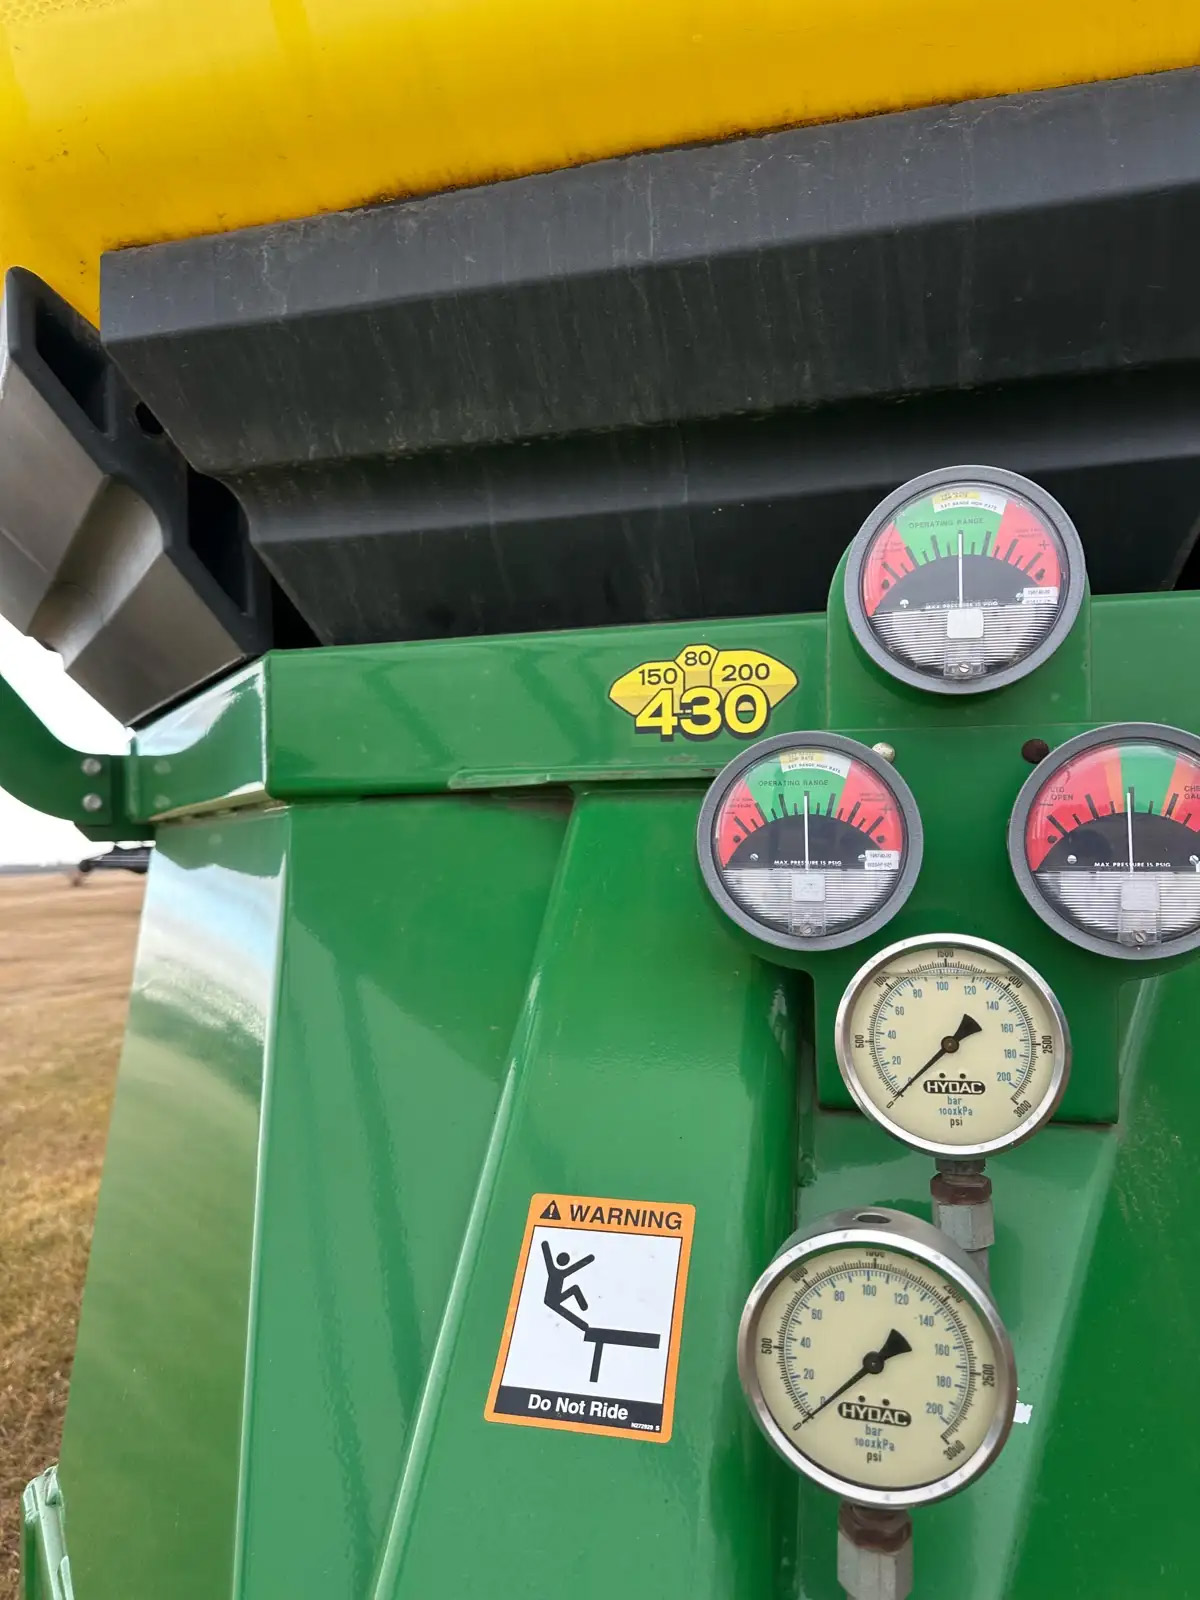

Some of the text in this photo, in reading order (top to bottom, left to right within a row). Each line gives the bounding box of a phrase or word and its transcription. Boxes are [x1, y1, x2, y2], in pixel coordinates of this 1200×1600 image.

[908, 517, 984, 529] OPERATING RANGE
[684, 650, 712, 666] 80
[638, 667, 678, 686] 150
[721, 662, 771, 682] 200
[635, 683, 770, 739] 430
[1051, 793, 1074, 801] OPEN
[936, 981, 949, 991] 100
[964, 985, 977, 996] 120
[912, 988, 923, 999] 80
[895, 1006, 905, 1016] 60
[986, 1000, 1000, 1011] 140
[1001, 1023, 1014, 1033] 160
[854, 1034, 865, 1049] 500
[887, 1030, 897, 1040] 40
[1041, 1035, 1053, 1054] 2500
[892, 1055, 902, 1065] 20
[1004, 1048, 1017, 1059] 180
[997, 1071, 1012, 1082] 200
[926, 1081, 983, 1094] HYDAC
[886, 1100, 894, 1109] 0
[947, 1095, 962, 1105] bar
[939, 1105, 973, 1116] 100xkPa
[1013, 1100, 1032, 1118] 3000
[950, 1116, 963, 1129] psi
[570, 1204, 682, 1230] WARNING
[789, 1267, 808, 1283] 1000
[834, 1290, 845, 1301] 80
[863, 1284, 877, 1296] 100
[894, 1293, 909, 1305] 120
[811, 1308, 822, 1320] 60
[919, 1314, 934, 1327] 140
[761, 1337, 773, 1354] 500
[800, 1337, 811, 1348] 40
[935, 1343, 950, 1356] 160
[804, 1368, 815, 1380] 20
[982, 1363, 994, 1387] 2500
[936, 1375, 952, 1388] 180
[528, 1393, 629, 1420] Do Not Ride
[926, 1402, 944, 1416] 200
[842, 1403, 908, 1426] HYDAC
[792, 1422, 802, 1431] 0
[865, 1423, 883, 1437] bar
[854, 1436, 895, 1452] 100xkPa
[943, 1439, 966, 1461] 3000
[866, 1450, 882, 1464] psi
